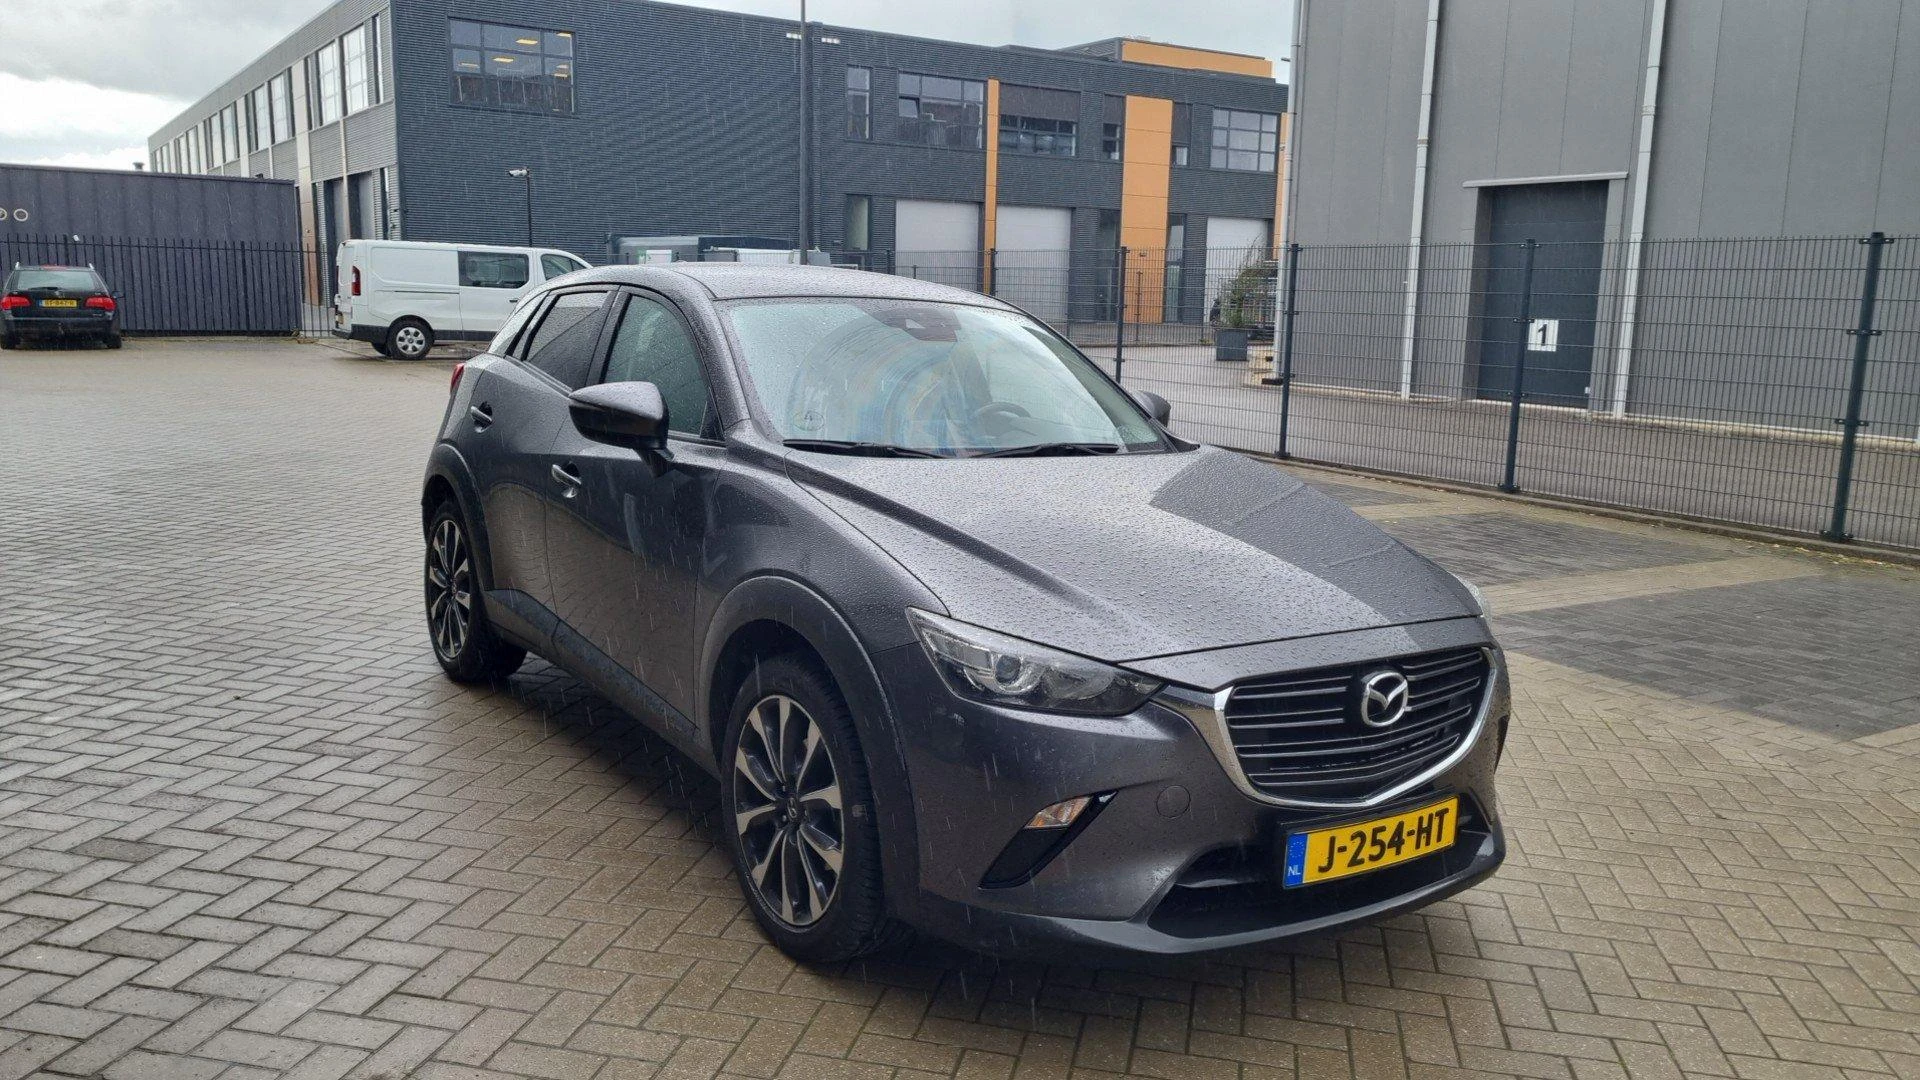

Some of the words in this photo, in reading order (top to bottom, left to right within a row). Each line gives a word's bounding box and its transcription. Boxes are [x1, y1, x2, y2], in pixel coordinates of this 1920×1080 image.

[1538, 324, 1548, 346] 1
[1317, 807, 1450, 873] J-254-HT
[1287, 864, 1301, 877] NL
